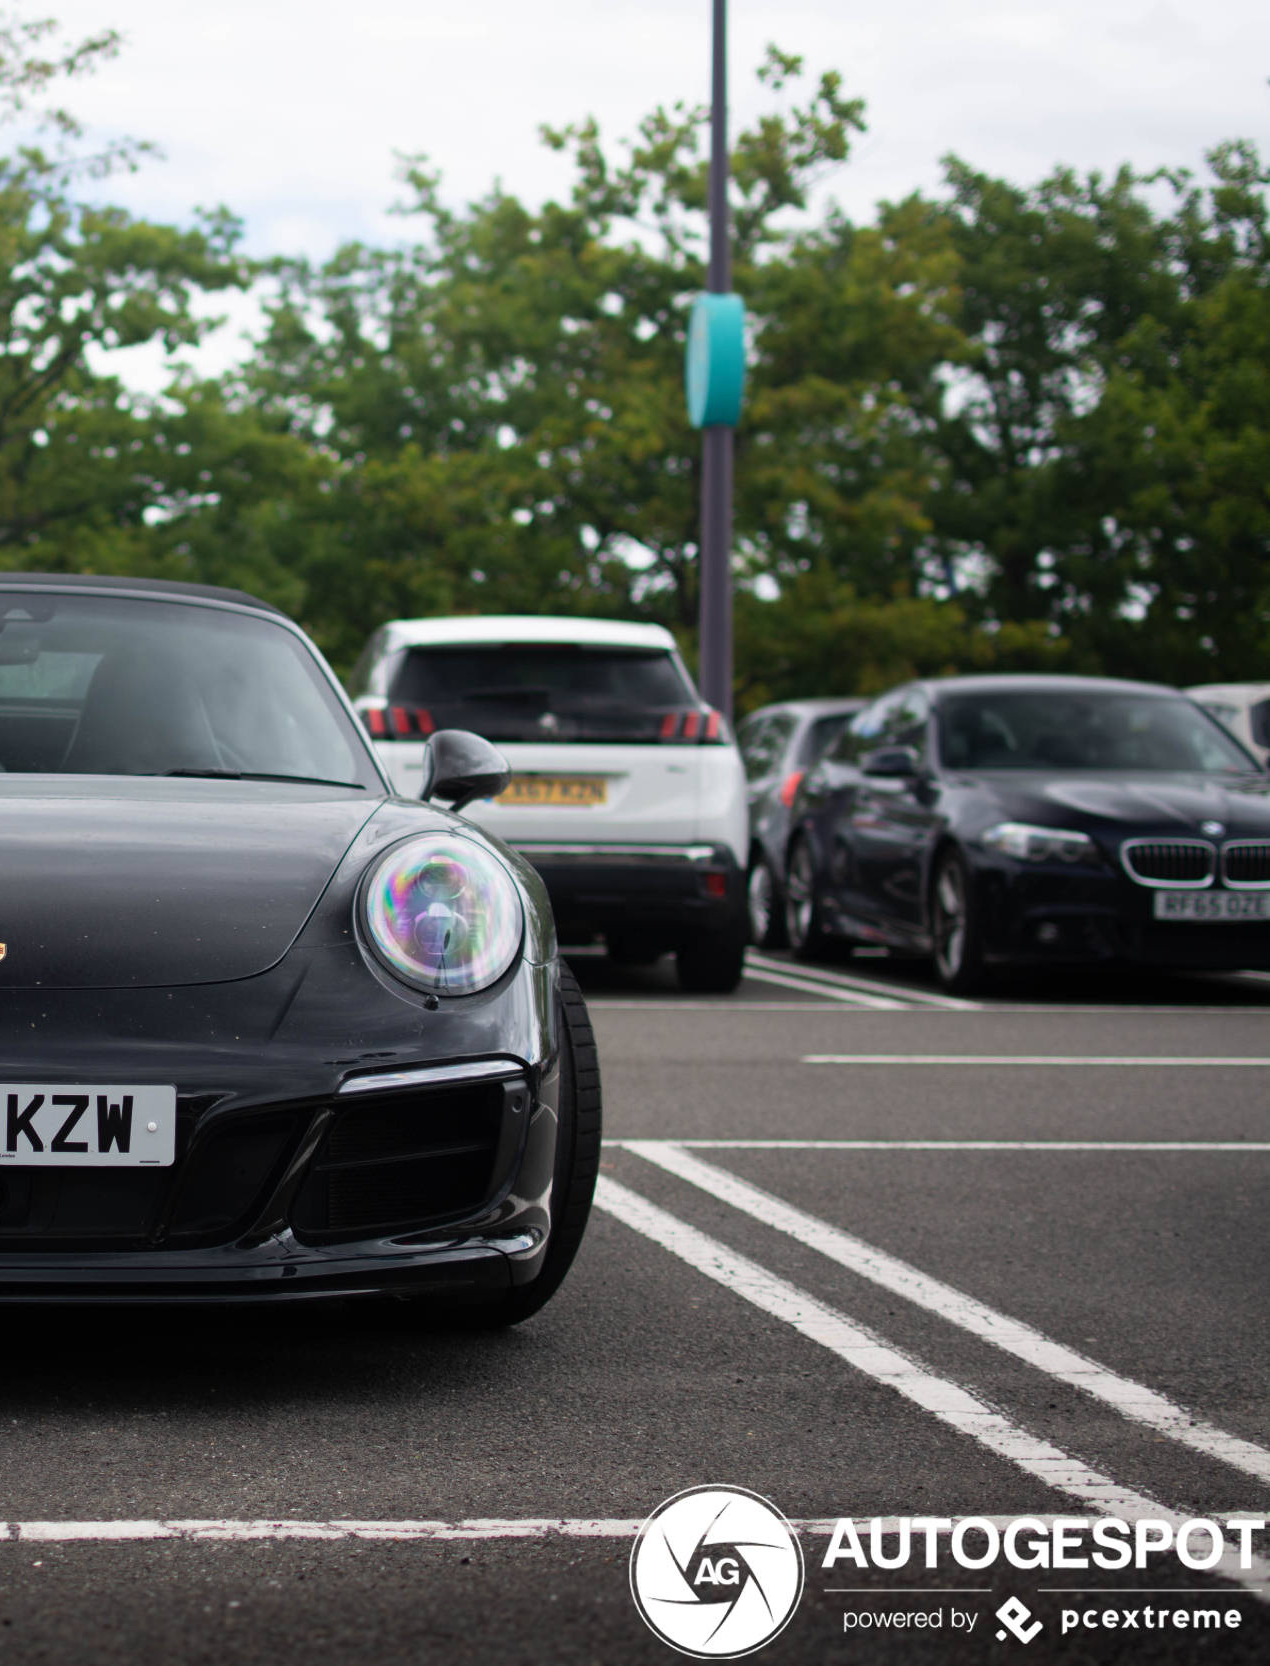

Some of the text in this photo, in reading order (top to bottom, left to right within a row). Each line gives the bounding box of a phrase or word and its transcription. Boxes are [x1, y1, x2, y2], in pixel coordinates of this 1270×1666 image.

[498, 780, 554, 799] X67
[1164, 895, 1221, 914] RF65
[7, 1094, 134, 1153] KZW
